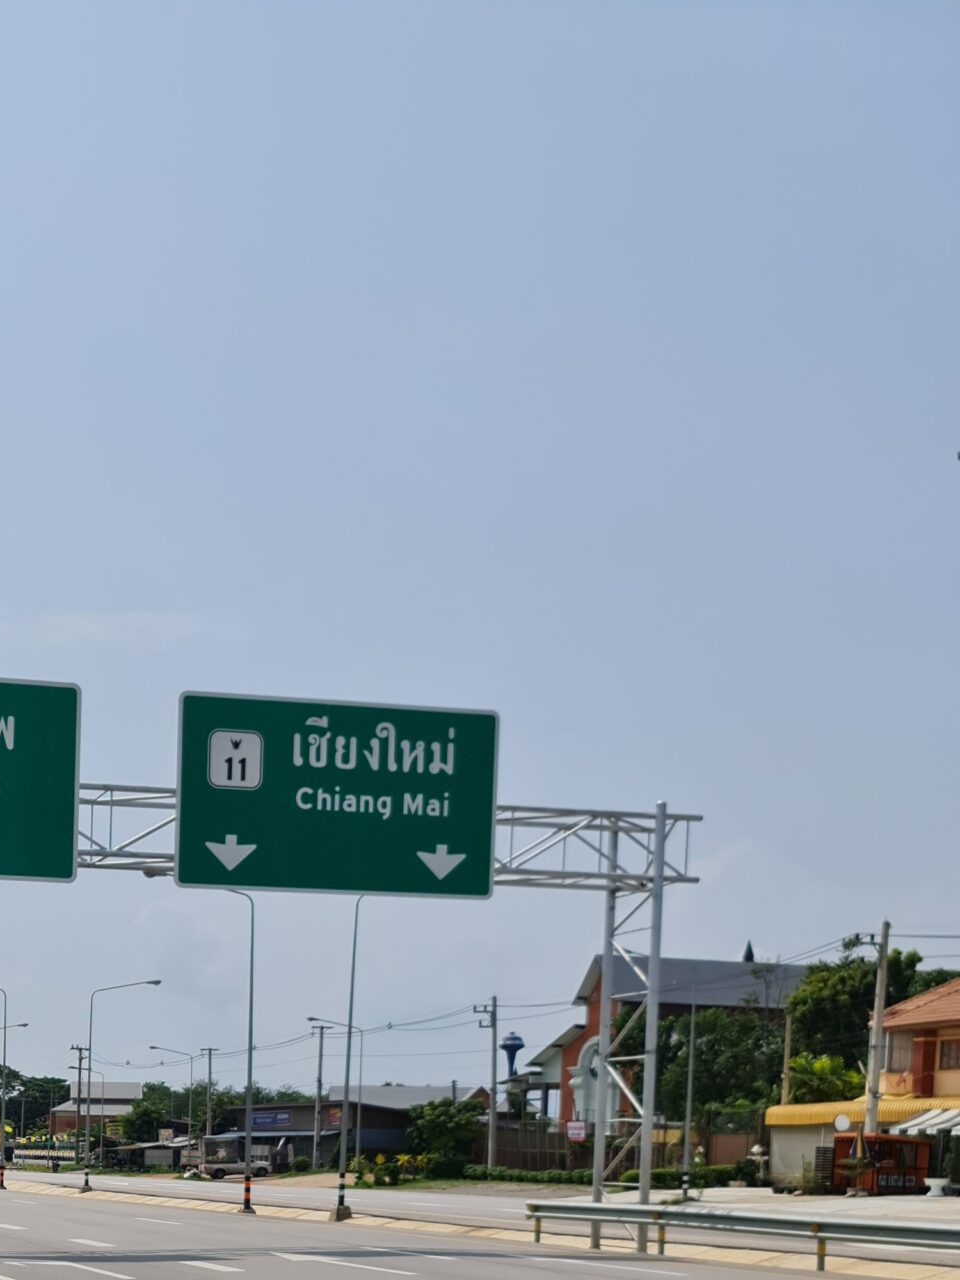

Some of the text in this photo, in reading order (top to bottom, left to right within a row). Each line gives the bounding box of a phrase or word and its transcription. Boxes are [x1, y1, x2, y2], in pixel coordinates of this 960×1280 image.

[292, 715, 455, 775] เชียงใหม่
[224, 756, 247, 782] 11
[295, 786, 449, 820] Chiang Mai
